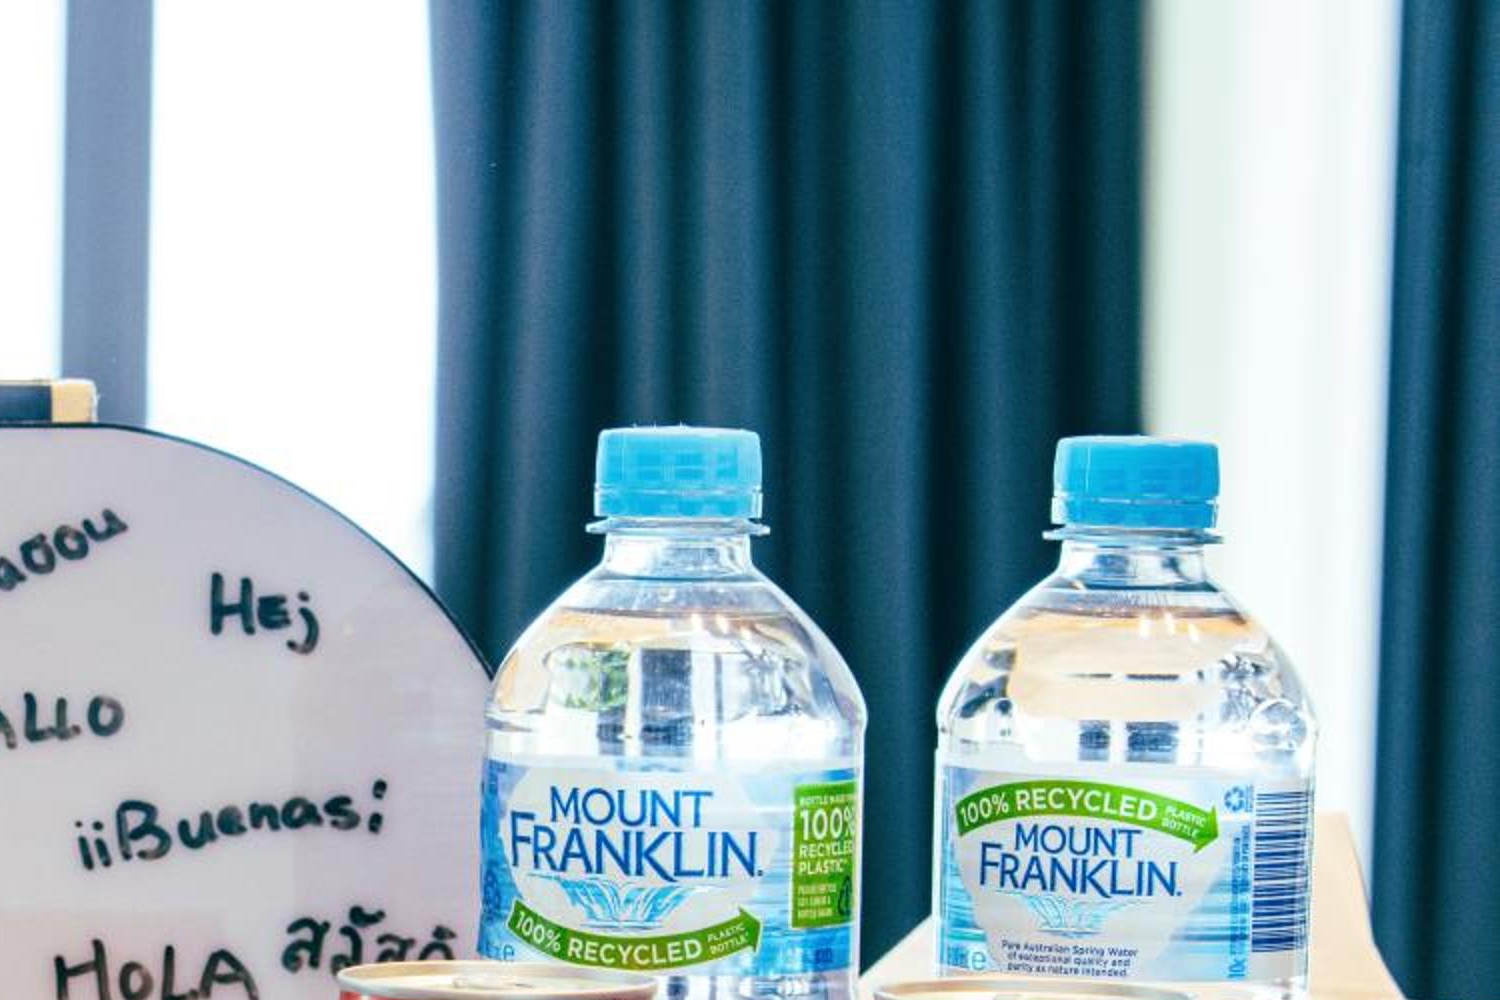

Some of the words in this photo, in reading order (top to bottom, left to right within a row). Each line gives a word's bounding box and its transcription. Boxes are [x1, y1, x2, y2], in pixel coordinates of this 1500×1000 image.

[550, 785, 713, 828] MOUNT
[960, 792, 1010, 827] 100%
[1015, 787, 1157, 821] RECYCLED
[1014, 822, 1143, 858] MOUNT
[515, 910, 561, 952] 100%
[567, 937, 701, 966] RECYCLED
[1001, 939, 1021, 950] Pure
[1023, 941, 1071, 954] Australian
[1072, 944, 1105, 957] Spring
[1108, 946, 1138, 958] Water
[1111, 957, 1131, 967] and
